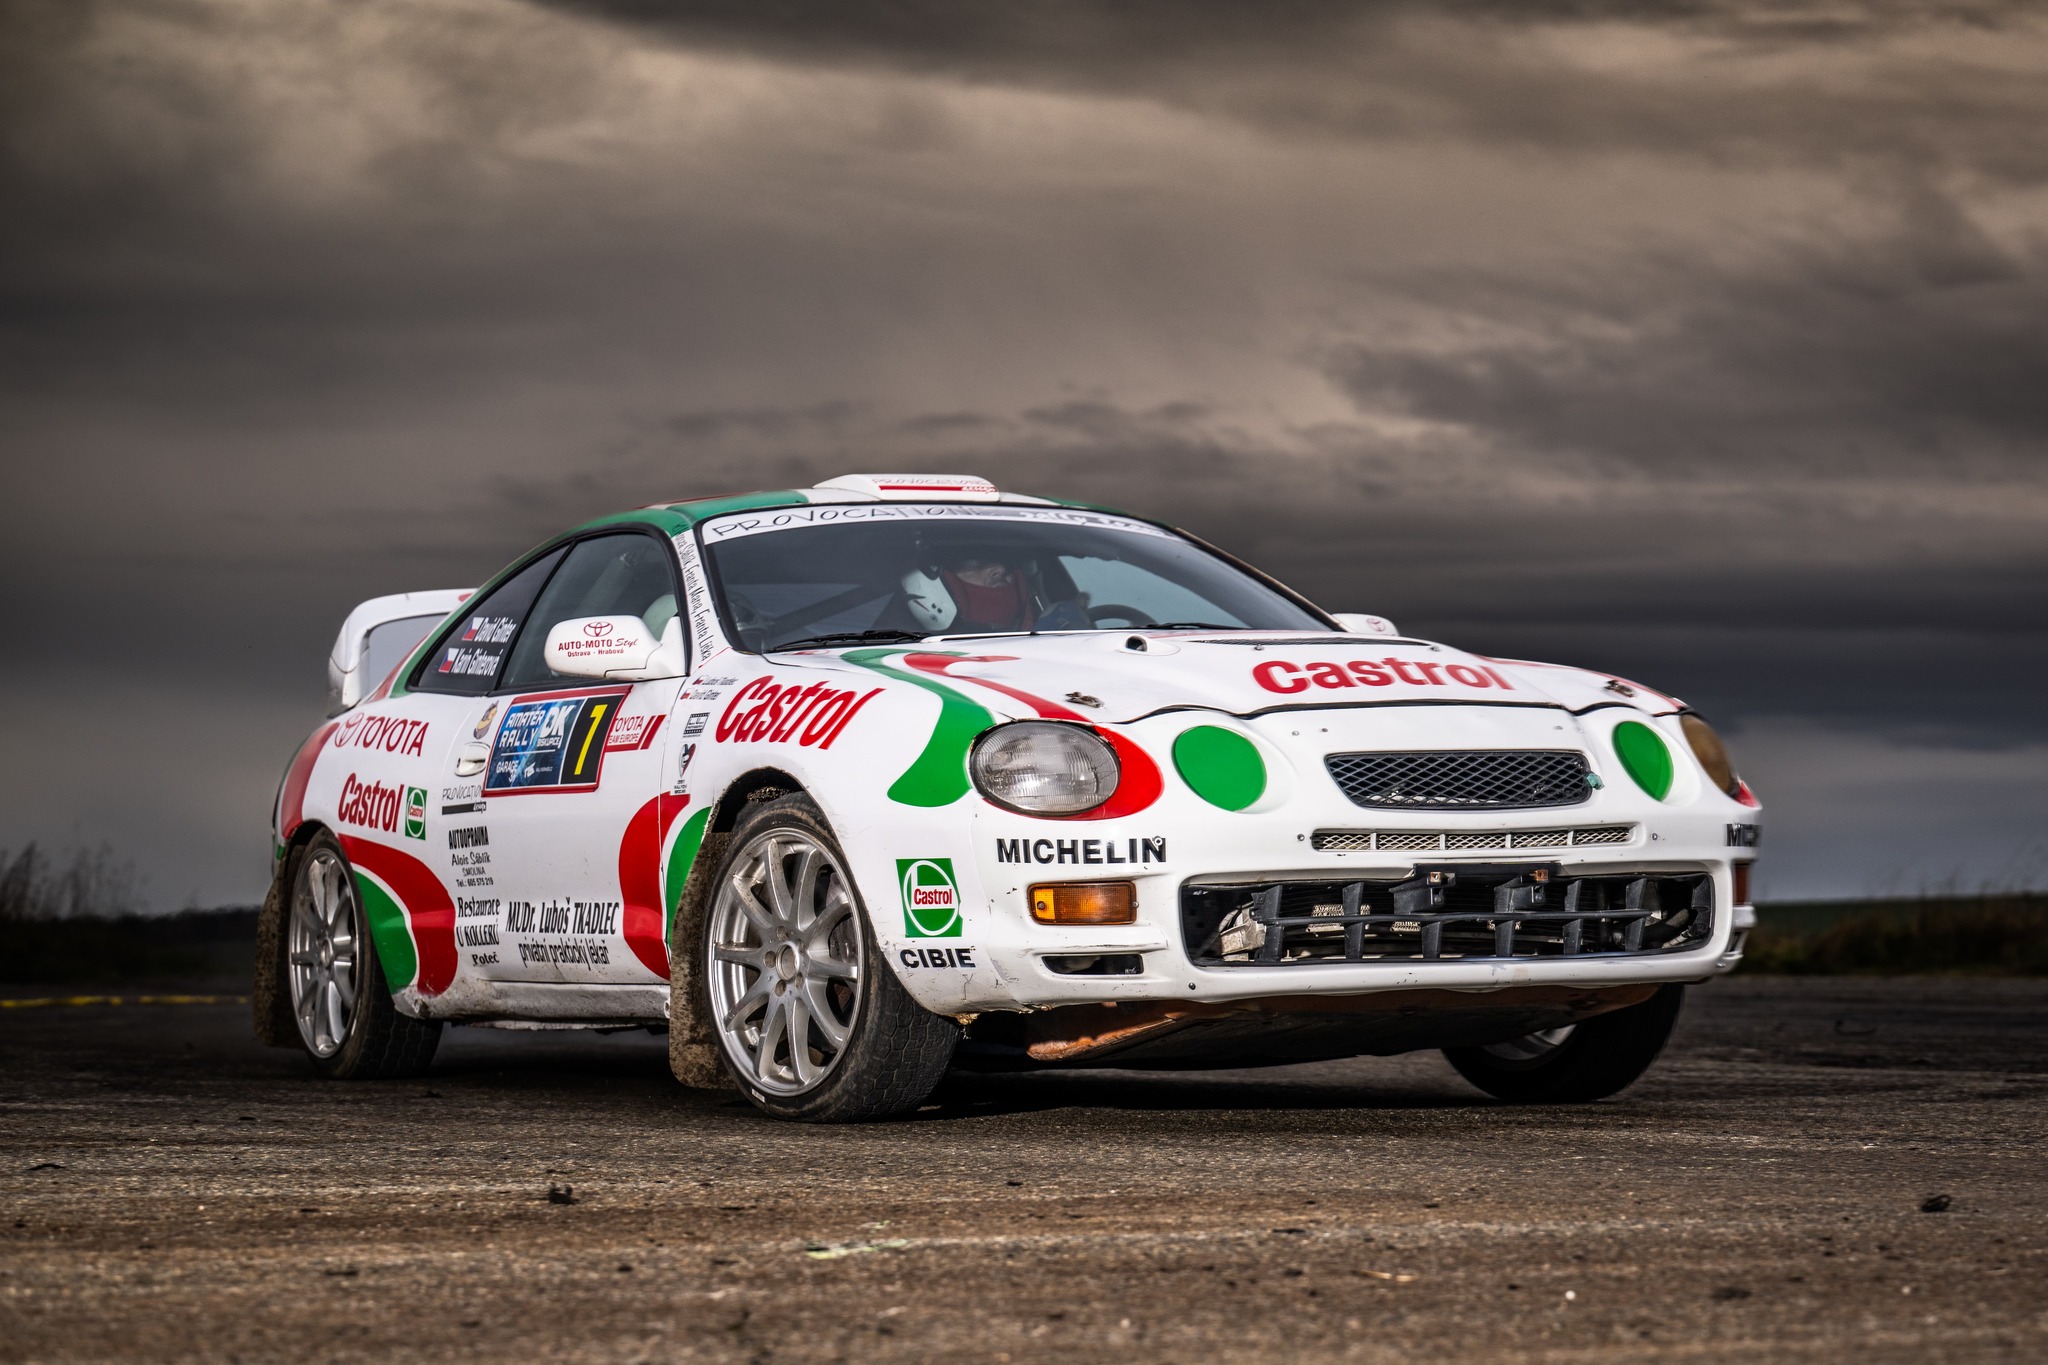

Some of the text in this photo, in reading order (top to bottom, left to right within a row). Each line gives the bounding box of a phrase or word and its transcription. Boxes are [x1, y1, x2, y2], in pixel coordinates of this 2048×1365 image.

[558, 638, 639, 651] AUTO-MOTO Styl
[1252, 656, 1516, 694] Castrol
[505, 706, 546, 728] AMATÉR
[715, 675, 887, 750] Castrol
[353, 716, 430, 757] TOYOTA
[498, 727, 539, 748] RALLY
[338, 772, 405, 833] Castrol
[448, 825, 490, 850] AUTOOPRAVNA
[451, 853, 470, 866] Alois
[996, 836, 1167, 865] MICHELIN
[457, 896, 500, 918] Restaurace
[913, 887, 953, 906] Castrol
[505, 896, 620, 935] MUDr. Luboš TKADLEC
[899, 948, 977, 968] CIBIE
